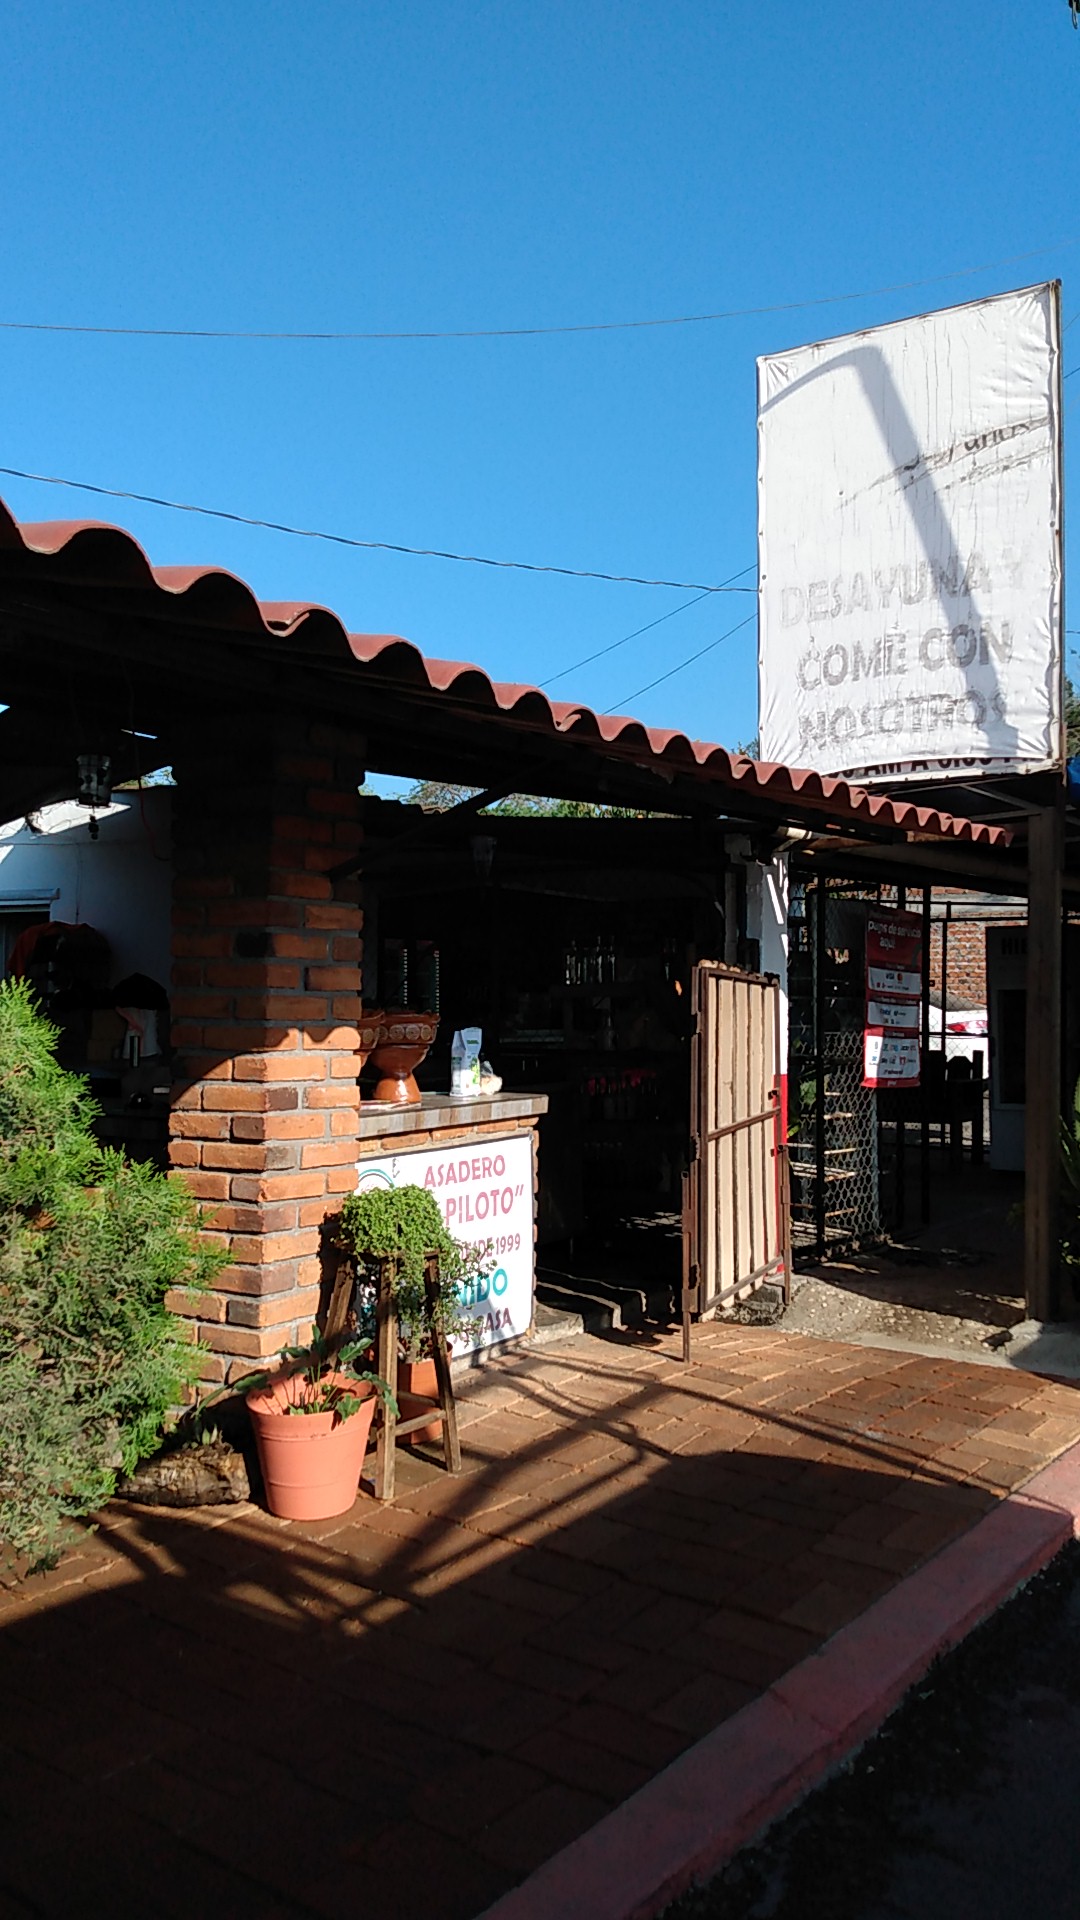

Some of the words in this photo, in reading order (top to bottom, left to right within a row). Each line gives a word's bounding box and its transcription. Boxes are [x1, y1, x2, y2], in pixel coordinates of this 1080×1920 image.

[780, 552, 992, 627] DESAYUNA
[798, 633, 907, 690] COME
[919, 622, 1013, 671] CON
[799, 689, 1007, 750] NOSOTROS
[424, 1155, 505, 1188] ASADERO
[496, 1233, 521, 1255] 1999
